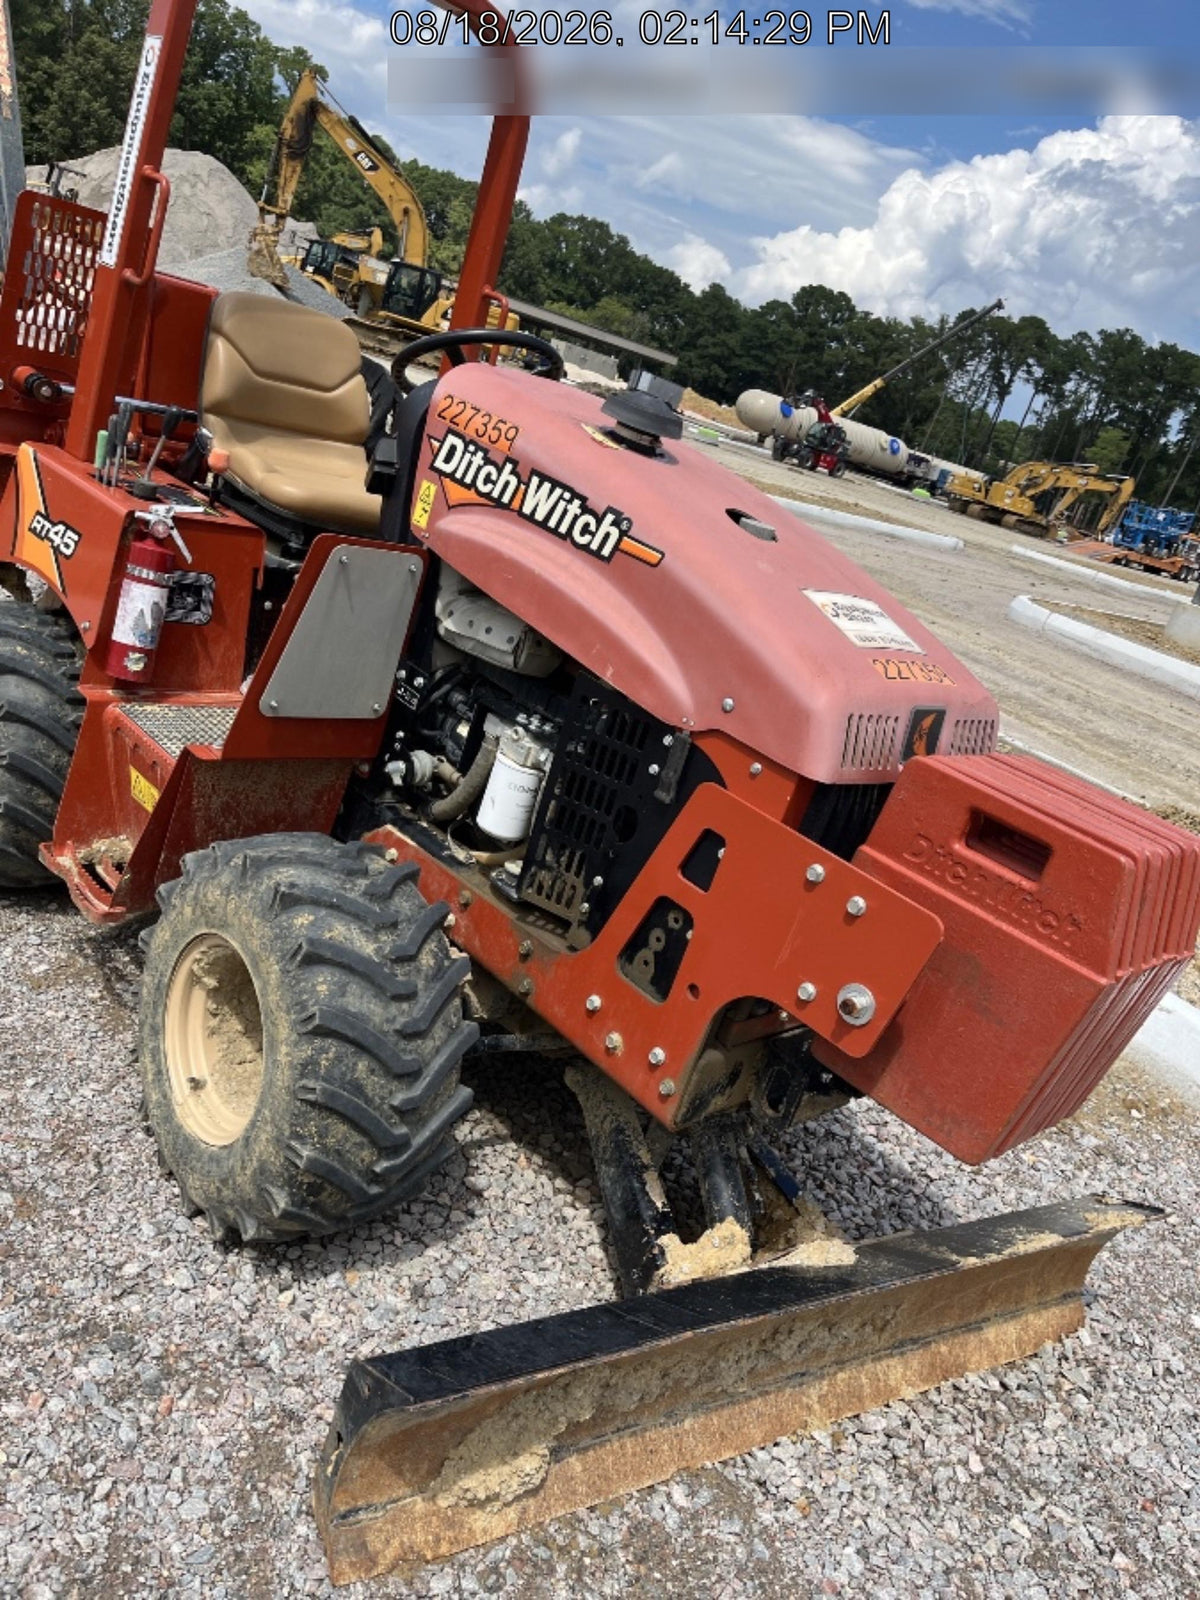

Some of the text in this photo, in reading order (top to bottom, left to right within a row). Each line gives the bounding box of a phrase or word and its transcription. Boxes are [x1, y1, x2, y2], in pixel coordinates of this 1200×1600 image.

[437, 394, 519, 450] 227359
[433, 434, 620, 557] Ditch Witch
[31, 514, 80, 556] RT45
[873, 658, 956, 685] 227359
